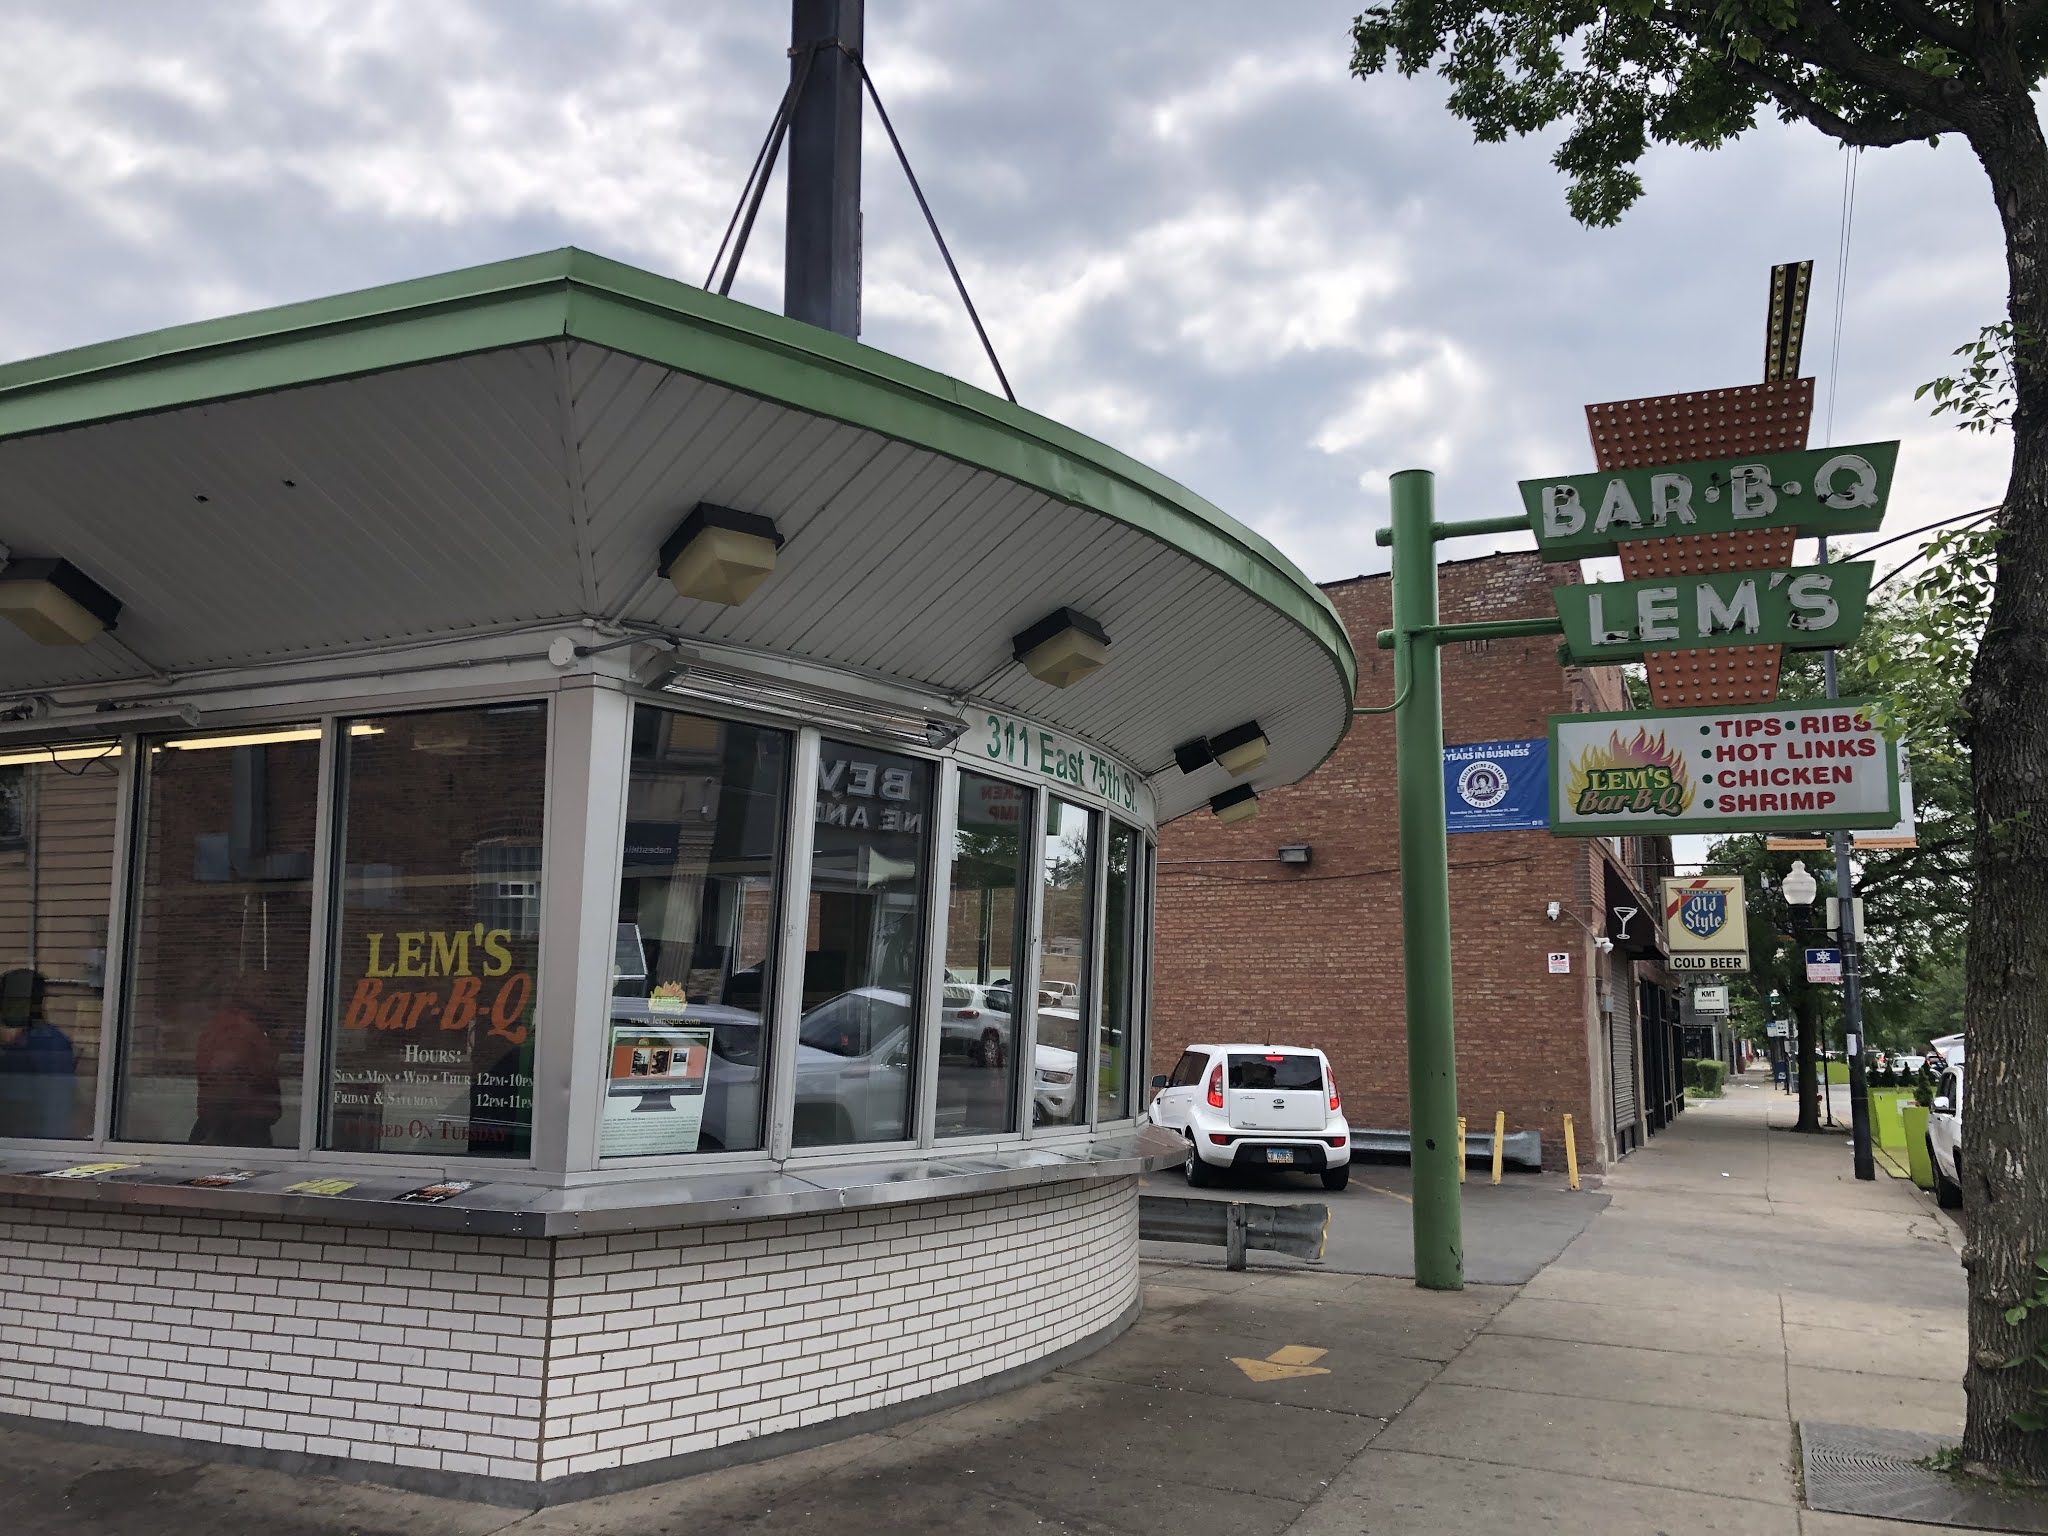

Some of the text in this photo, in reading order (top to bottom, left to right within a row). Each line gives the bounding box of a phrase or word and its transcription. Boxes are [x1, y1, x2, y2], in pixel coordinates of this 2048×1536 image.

[1588, 572, 1839, 646] LEM'S
[1715, 713, 1873, 738] TIPS RIBS
[1446, 751, 1474, 761] YEARS
[1475, 751, 1486, 759] IN
[1486, 748, 1530, 759] BUSINESS
[1716, 738, 1877, 763] HOT LINKS
[986, 715, 1138, 813] 311 East 75th St.
[1590, 766, 1671, 791] LEM'S
[1717, 765, 1853, 789] CHICKEN
[1719, 791, 1836, 813] SHRIMP
[1691, 896, 1716, 912] Old
[1685, 910, 1722, 934] Style
[365, 923, 513, 978] LEM'S
[1674, 957, 1742, 968] COLD BEER
[373, 1092, 384, 1105] &
